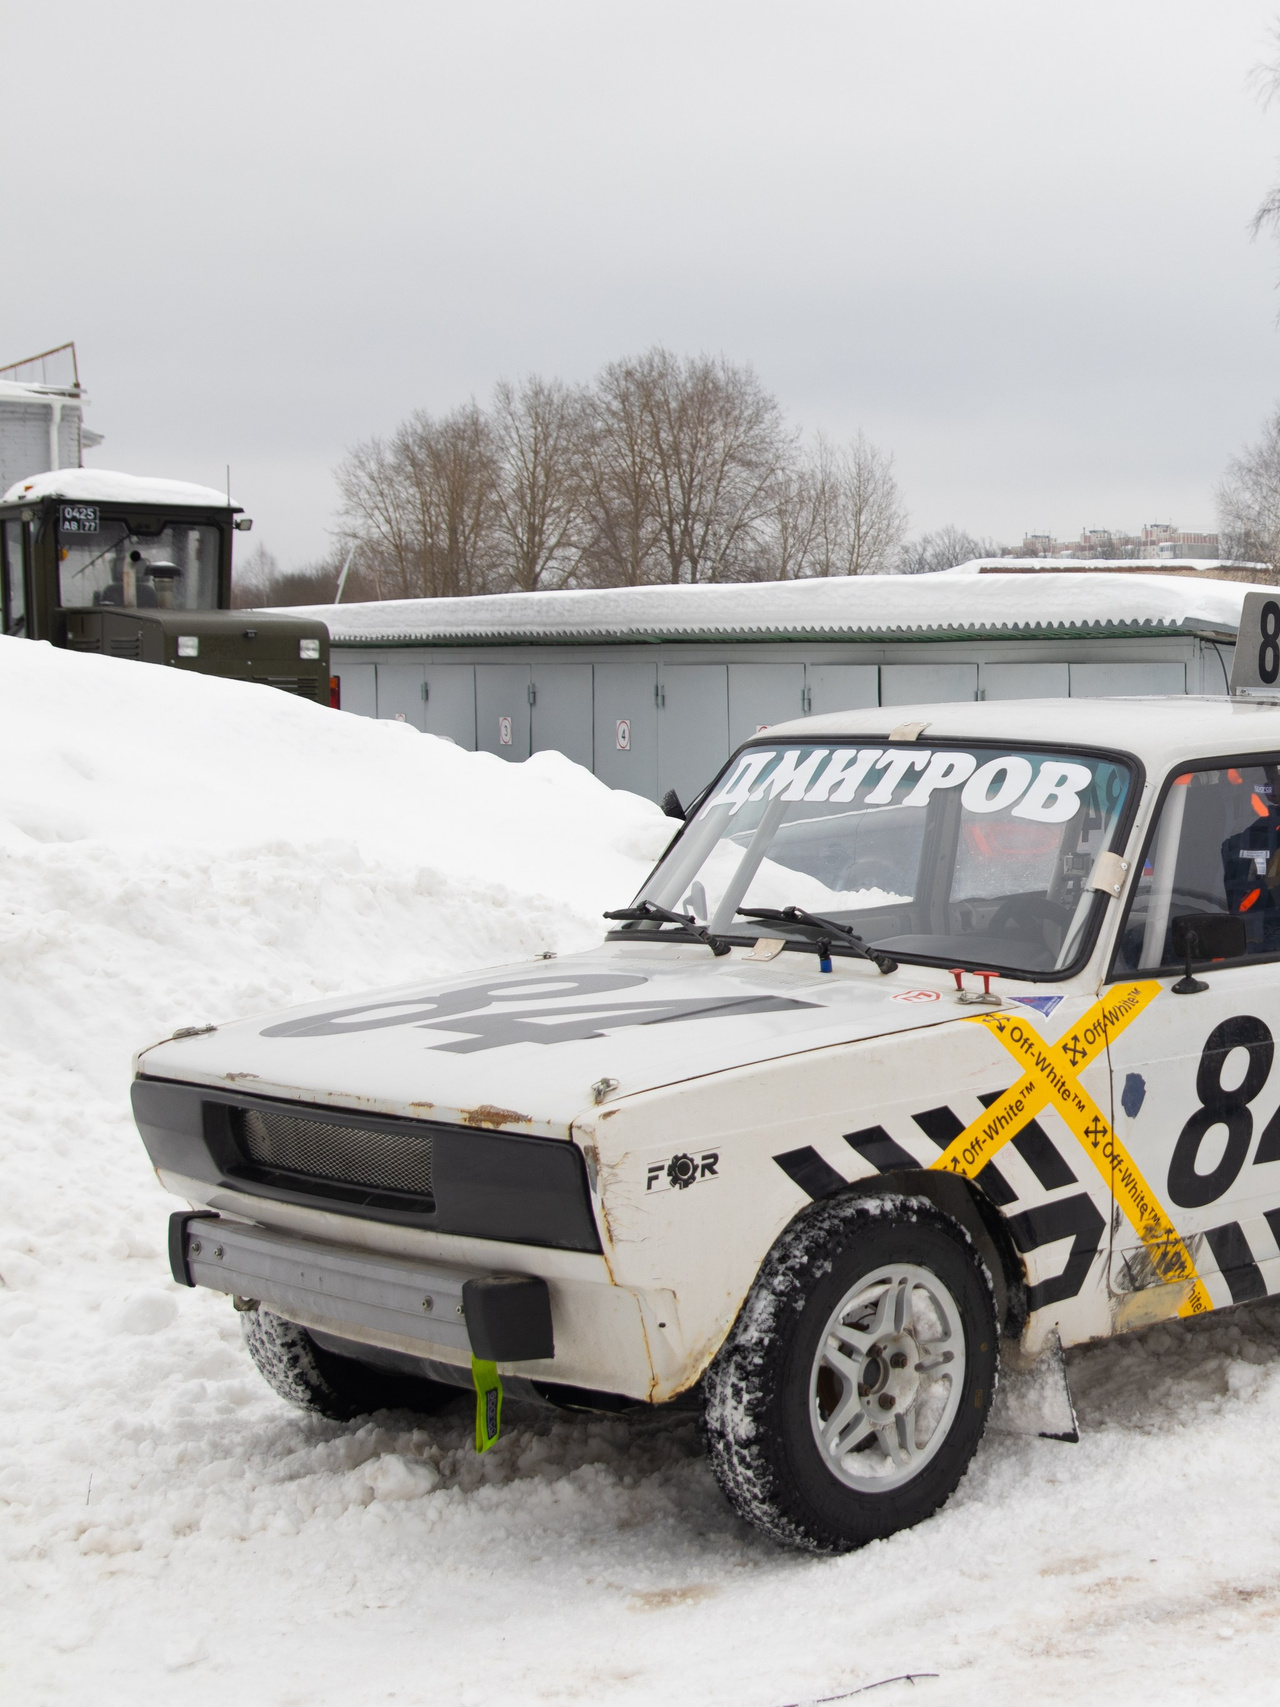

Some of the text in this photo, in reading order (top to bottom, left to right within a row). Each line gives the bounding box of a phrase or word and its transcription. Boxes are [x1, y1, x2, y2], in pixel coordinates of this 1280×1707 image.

[64, 507, 95, 519] 0425
[84, 522, 96, 531] 77
[699, 748, 1093, 823] ДМИТРОВ
[259, 974, 828, 1054] 84
[646, 1153, 719, 1190] FOR
